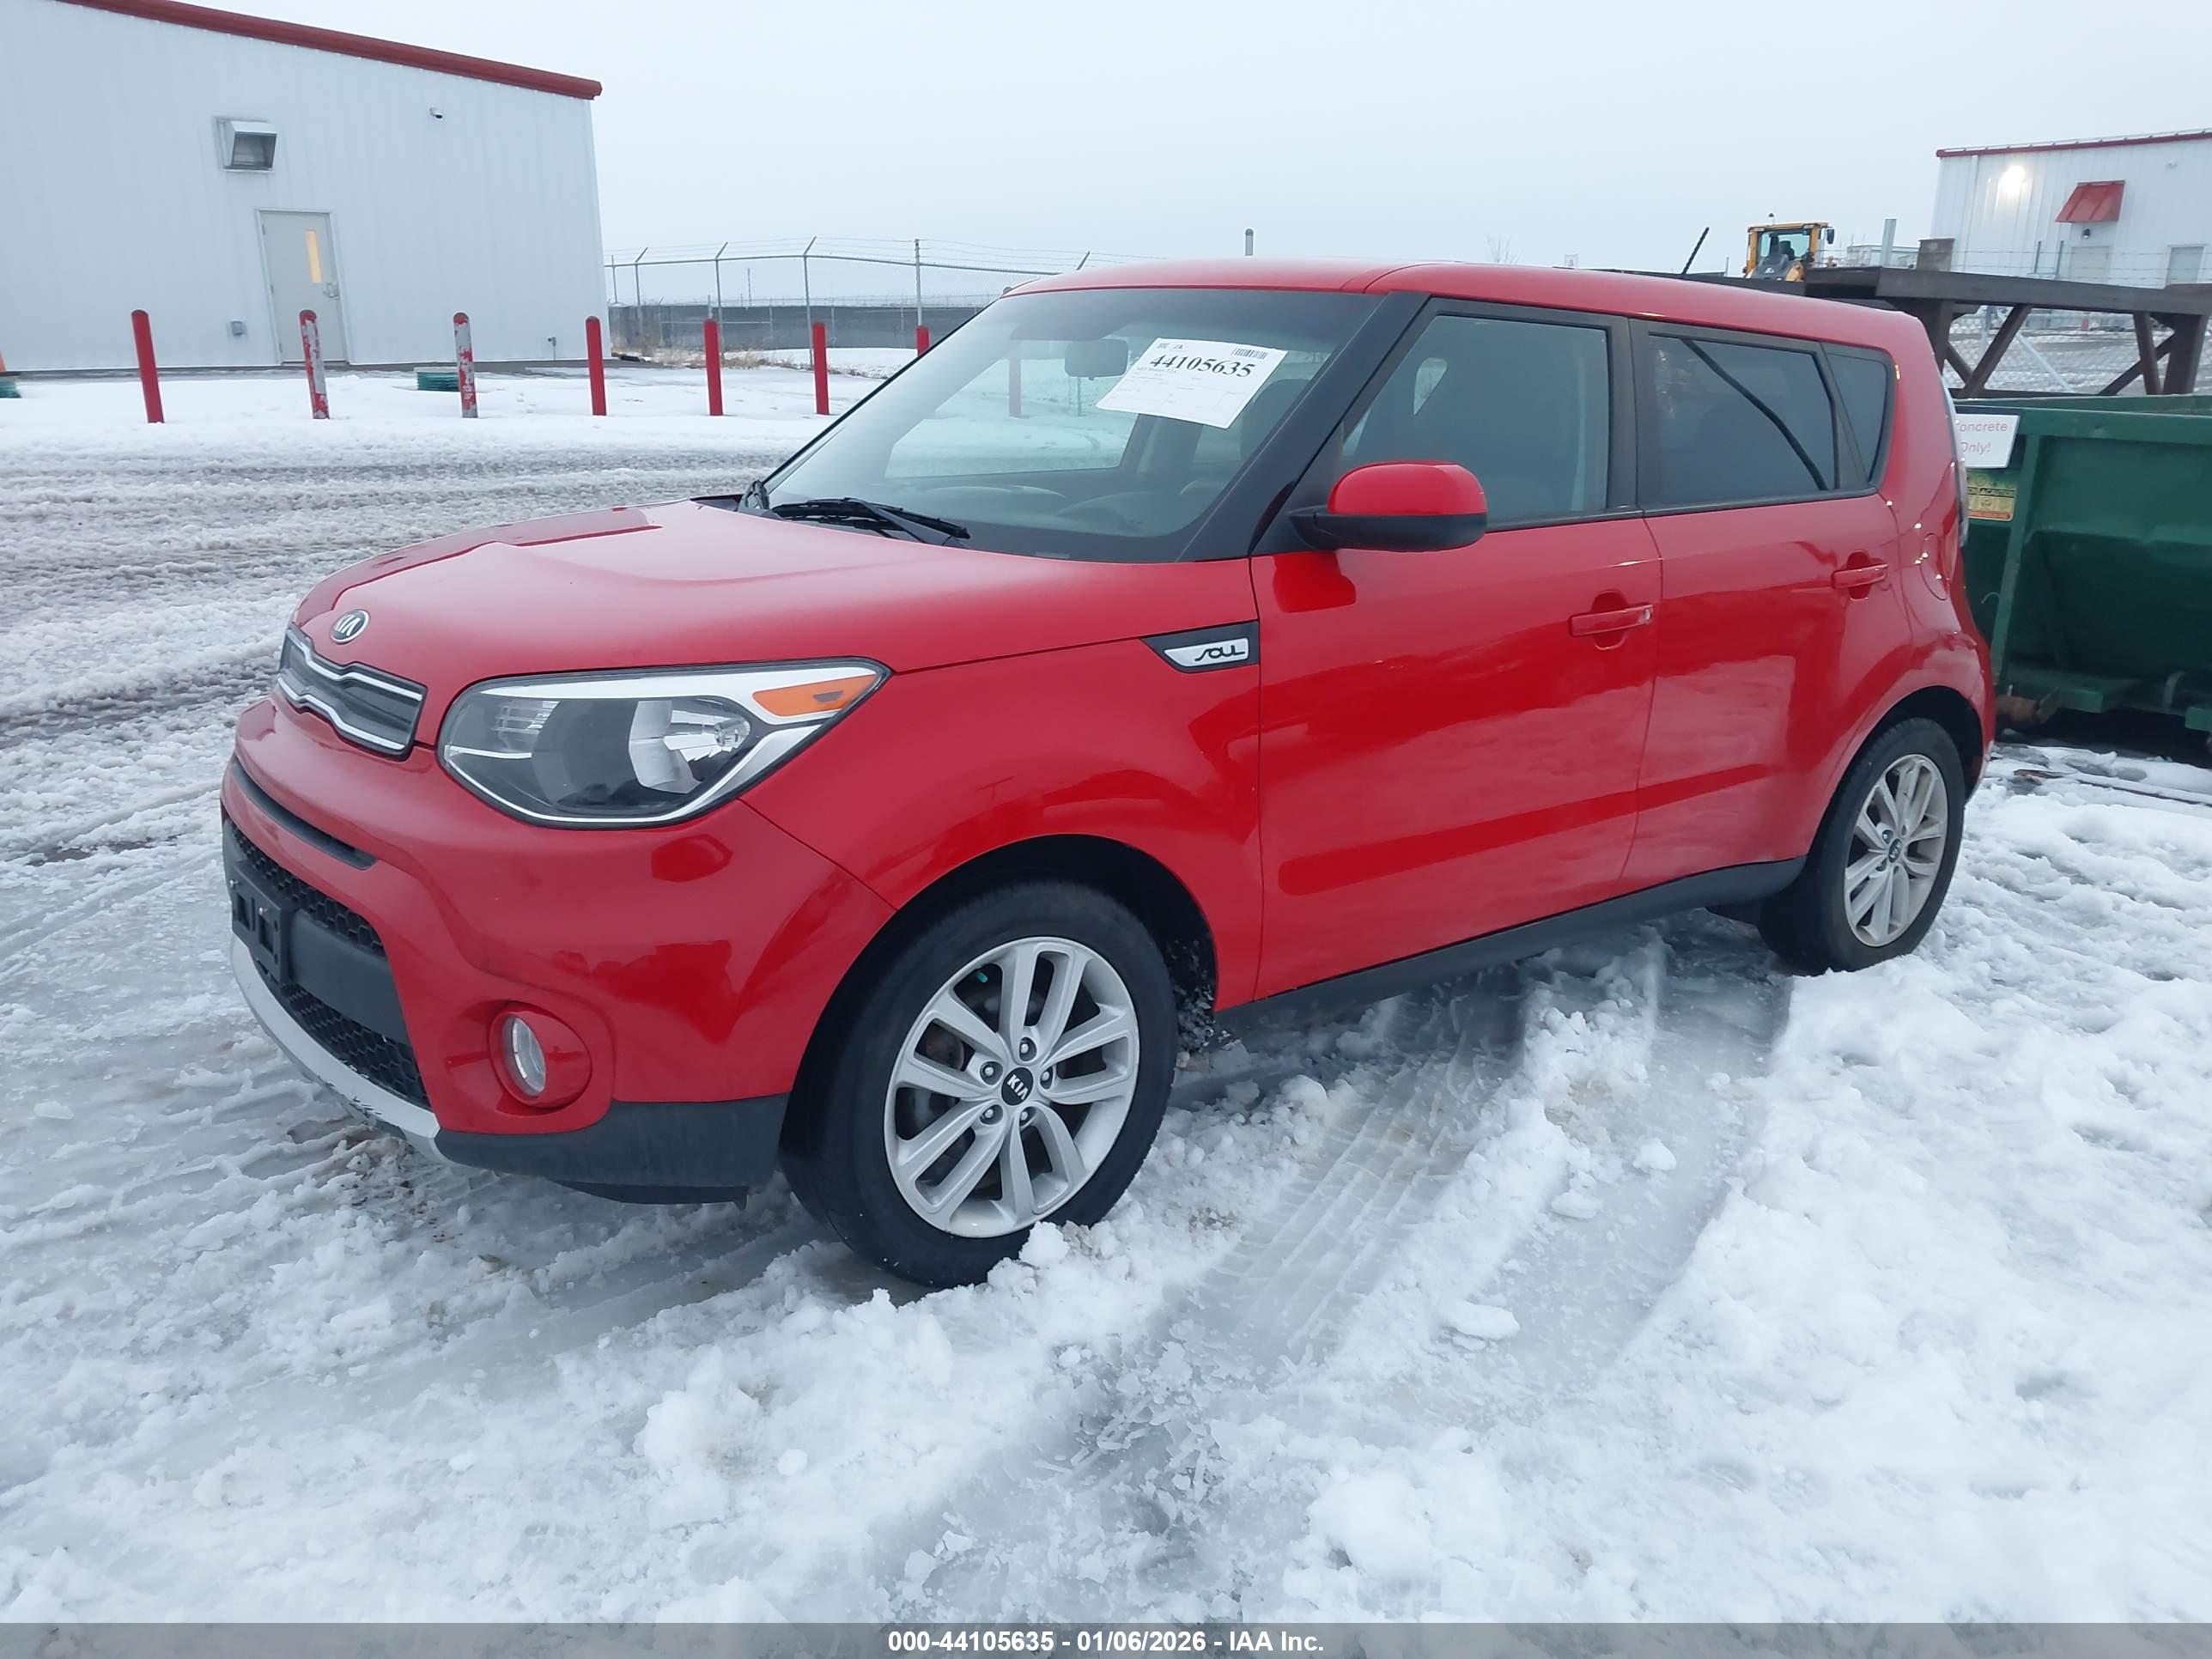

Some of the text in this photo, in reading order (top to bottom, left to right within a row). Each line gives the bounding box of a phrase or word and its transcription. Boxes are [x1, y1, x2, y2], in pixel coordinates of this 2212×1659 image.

[1149, 354, 1257, 378] 44105635
[1958, 422, 2008, 432] oncrete
[1006, 1073, 1029, 1101] KIA
